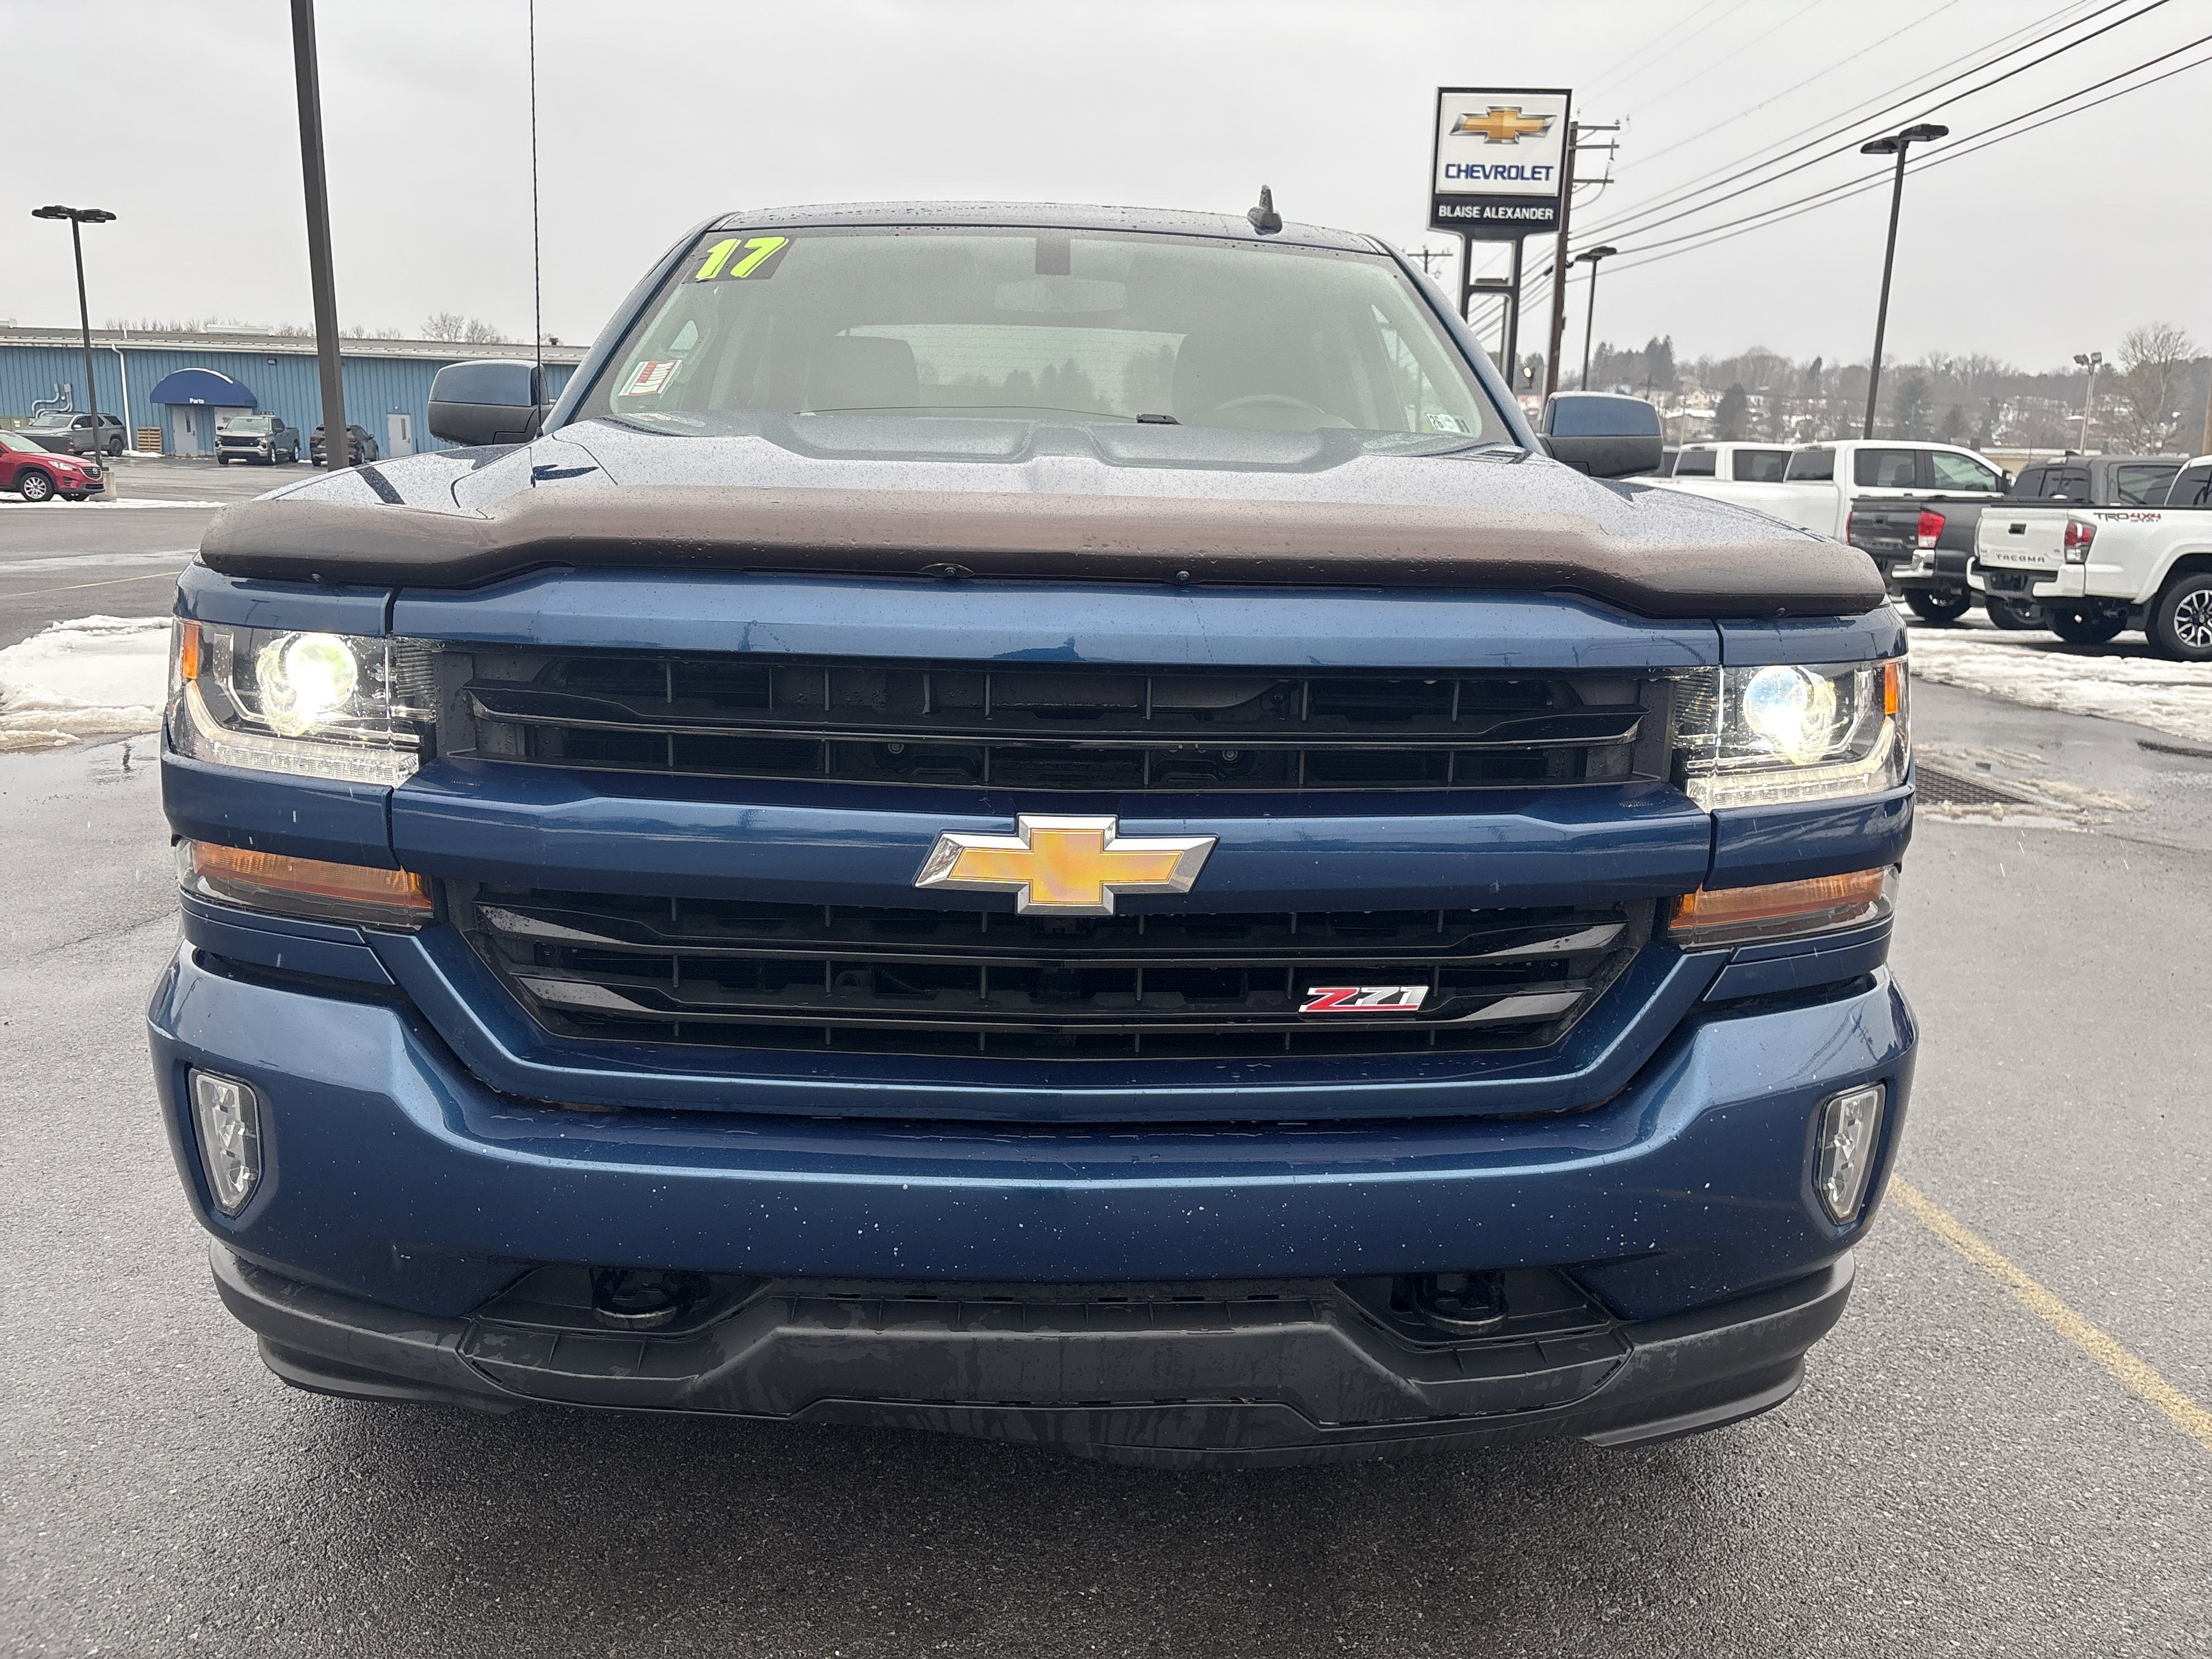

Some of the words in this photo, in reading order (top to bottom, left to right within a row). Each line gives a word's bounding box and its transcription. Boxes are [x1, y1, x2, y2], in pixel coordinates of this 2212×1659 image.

[1445, 163, 1554, 181] CHEVROLET
[1438, 205, 1481, 218] BLAISE
[1482, 206, 1554, 220] ALEXANDER
[695, 236, 789, 280] 17
[1996, 553, 2045, 563] TACOMA
[1298, 986, 1429, 1012] Z71
